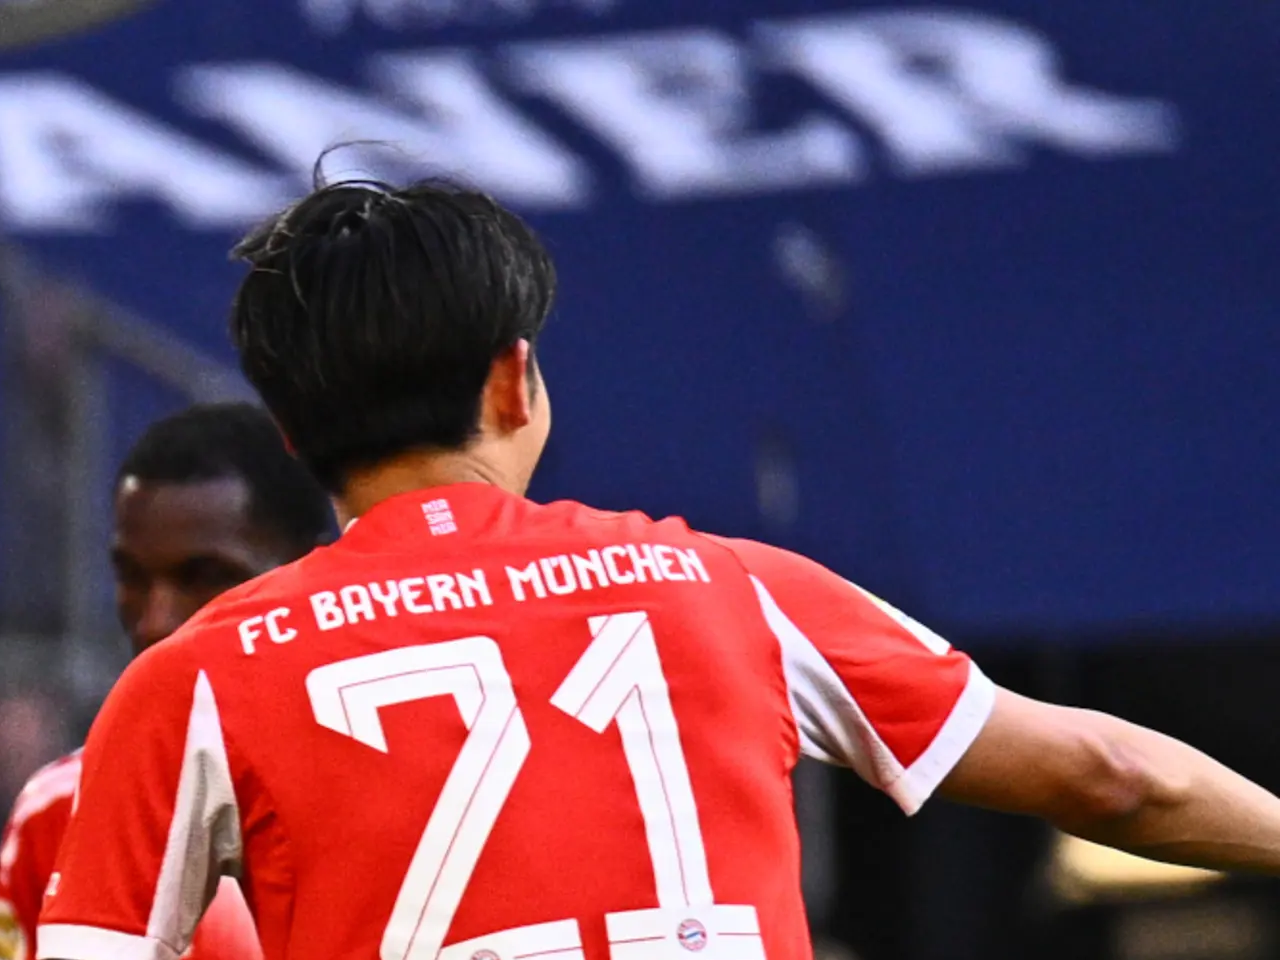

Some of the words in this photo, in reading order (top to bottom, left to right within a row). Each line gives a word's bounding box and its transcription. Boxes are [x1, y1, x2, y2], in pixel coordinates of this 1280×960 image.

[237, 606, 298, 655] FC
[309, 568, 494, 632] BAYERN
[504, 542, 713, 602] MÜNCHEN
